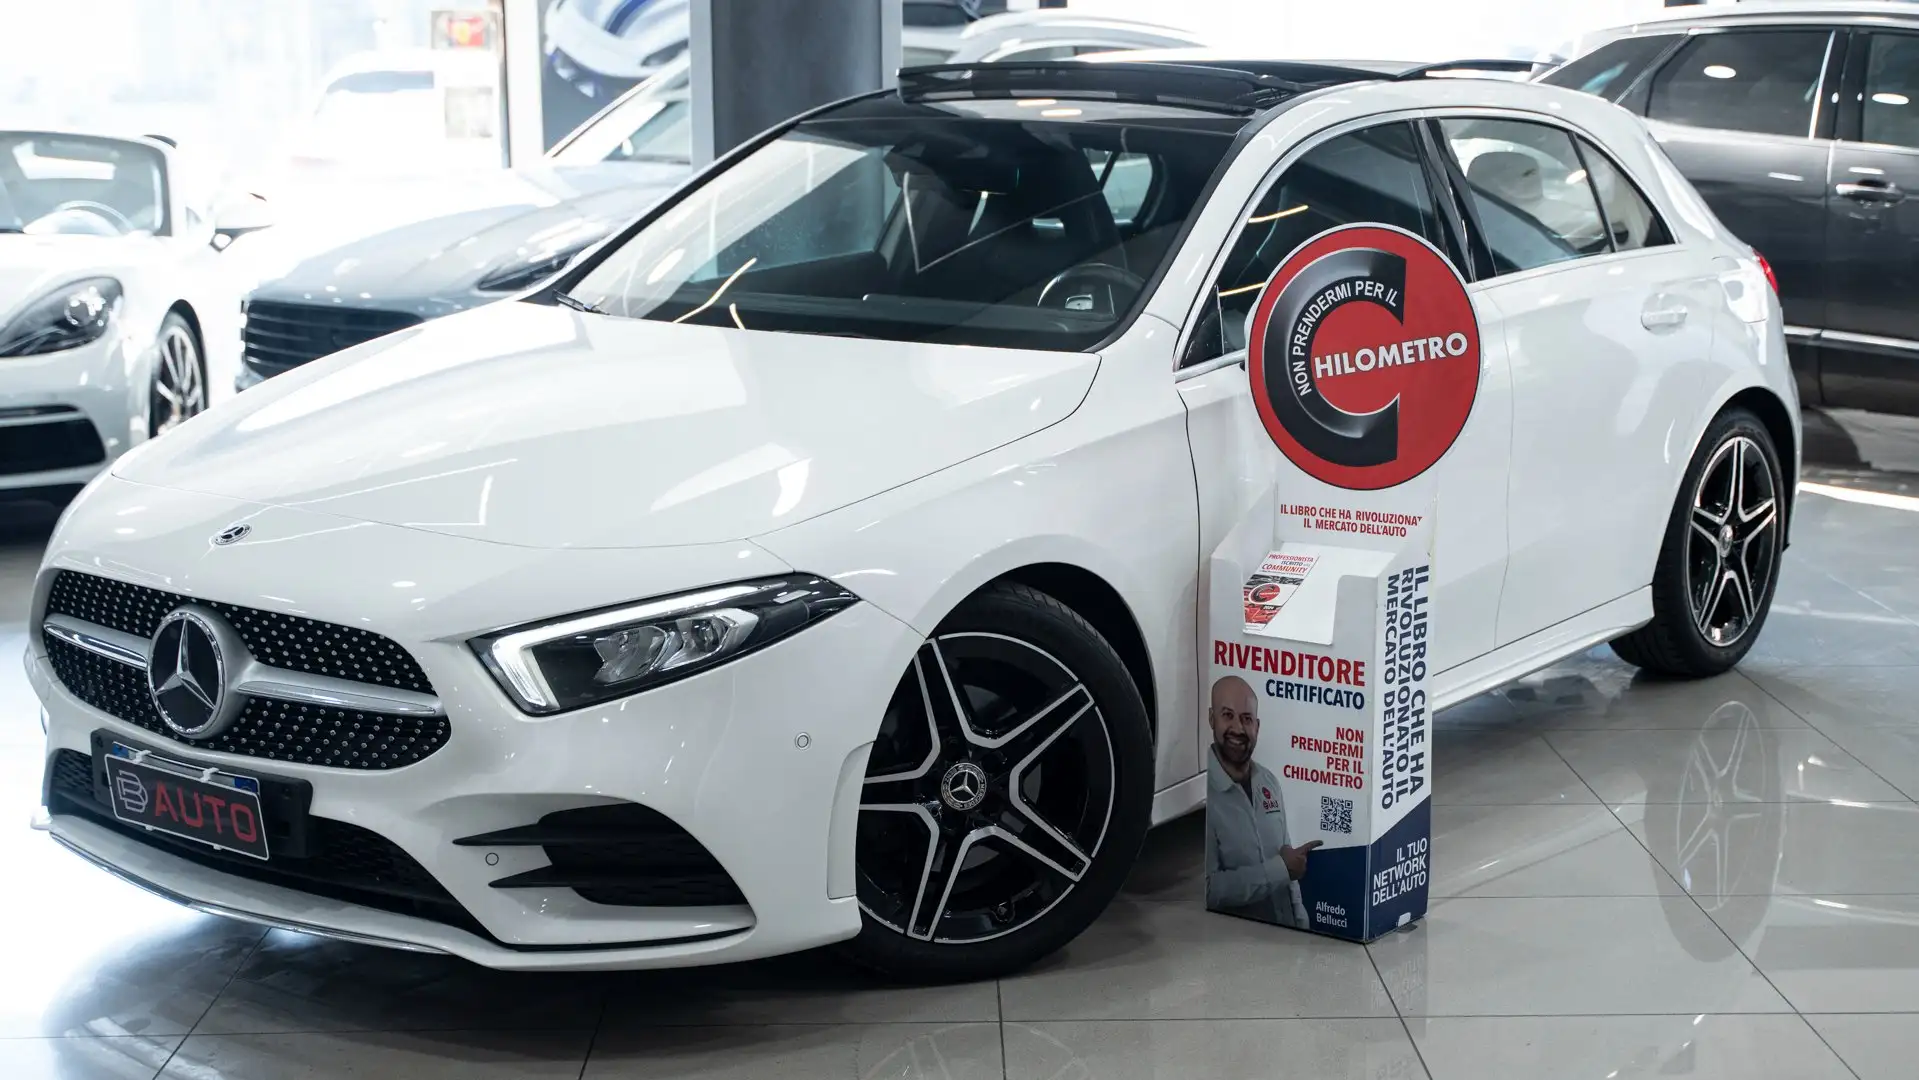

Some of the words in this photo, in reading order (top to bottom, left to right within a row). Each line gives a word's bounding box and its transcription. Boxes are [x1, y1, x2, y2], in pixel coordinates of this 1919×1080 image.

[1355, 280, 1385, 299] PER
[1385, 287, 1399, 308] IL
[1292, 282, 1352, 357] PRENDERMI
[1292, 360, 1313, 397] NON
[1280, 503, 1289, 515] IL
[1290, 504, 1317, 517] LIBRO
[1319, 507, 1337, 519] CHE
[1339, 508, 1352, 521] HA
[1303, 517, 1312, 529] IL
[1315, 519, 1358, 533] MERCATO
[1360, 523, 1407, 538] DELL'AUTO
[1261, 563, 1308, 574] COMMUNITY
[1268, 554, 1314, 563] PROFESSIONISTA
[1415, 565, 1429, 592] IL
[1384, 574, 1400, 685] MERCATO
[1411, 596, 1429, 682] LIBRO
[1214, 639, 1366, 687] RIVENDITORE
[1396, 567, 1414, 773] RIVOLUZIONATO
[1265, 678, 1365, 710] CERTIFICATO
[1411, 689, 1426, 747] CHE
[1291, 735, 1364, 759] PRENDERMI
[1336, 726, 1364, 744] NON
[1381, 690, 1396, 810] DELL'AUTO
[1283, 764, 1363, 790] CHILOMETRO
[1326, 756, 1350, 772] PER
[1353, 760, 1364, 775] IL
[1410, 752, 1425, 795] HA
[1396, 778, 1409, 803] IL
[154, 780, 258, 843] AUTO
[1396, 847, 1406, 863] IL
[1407, 837, 1428, 858] TUO
[1373, 853, 1427, 890] NETWORK
[1372, 870, 1427, 907] DELL'AUTO
[1315, 901, 1346, 916] Alfredo
[1316, 913, 1348, 928] Bellucci
